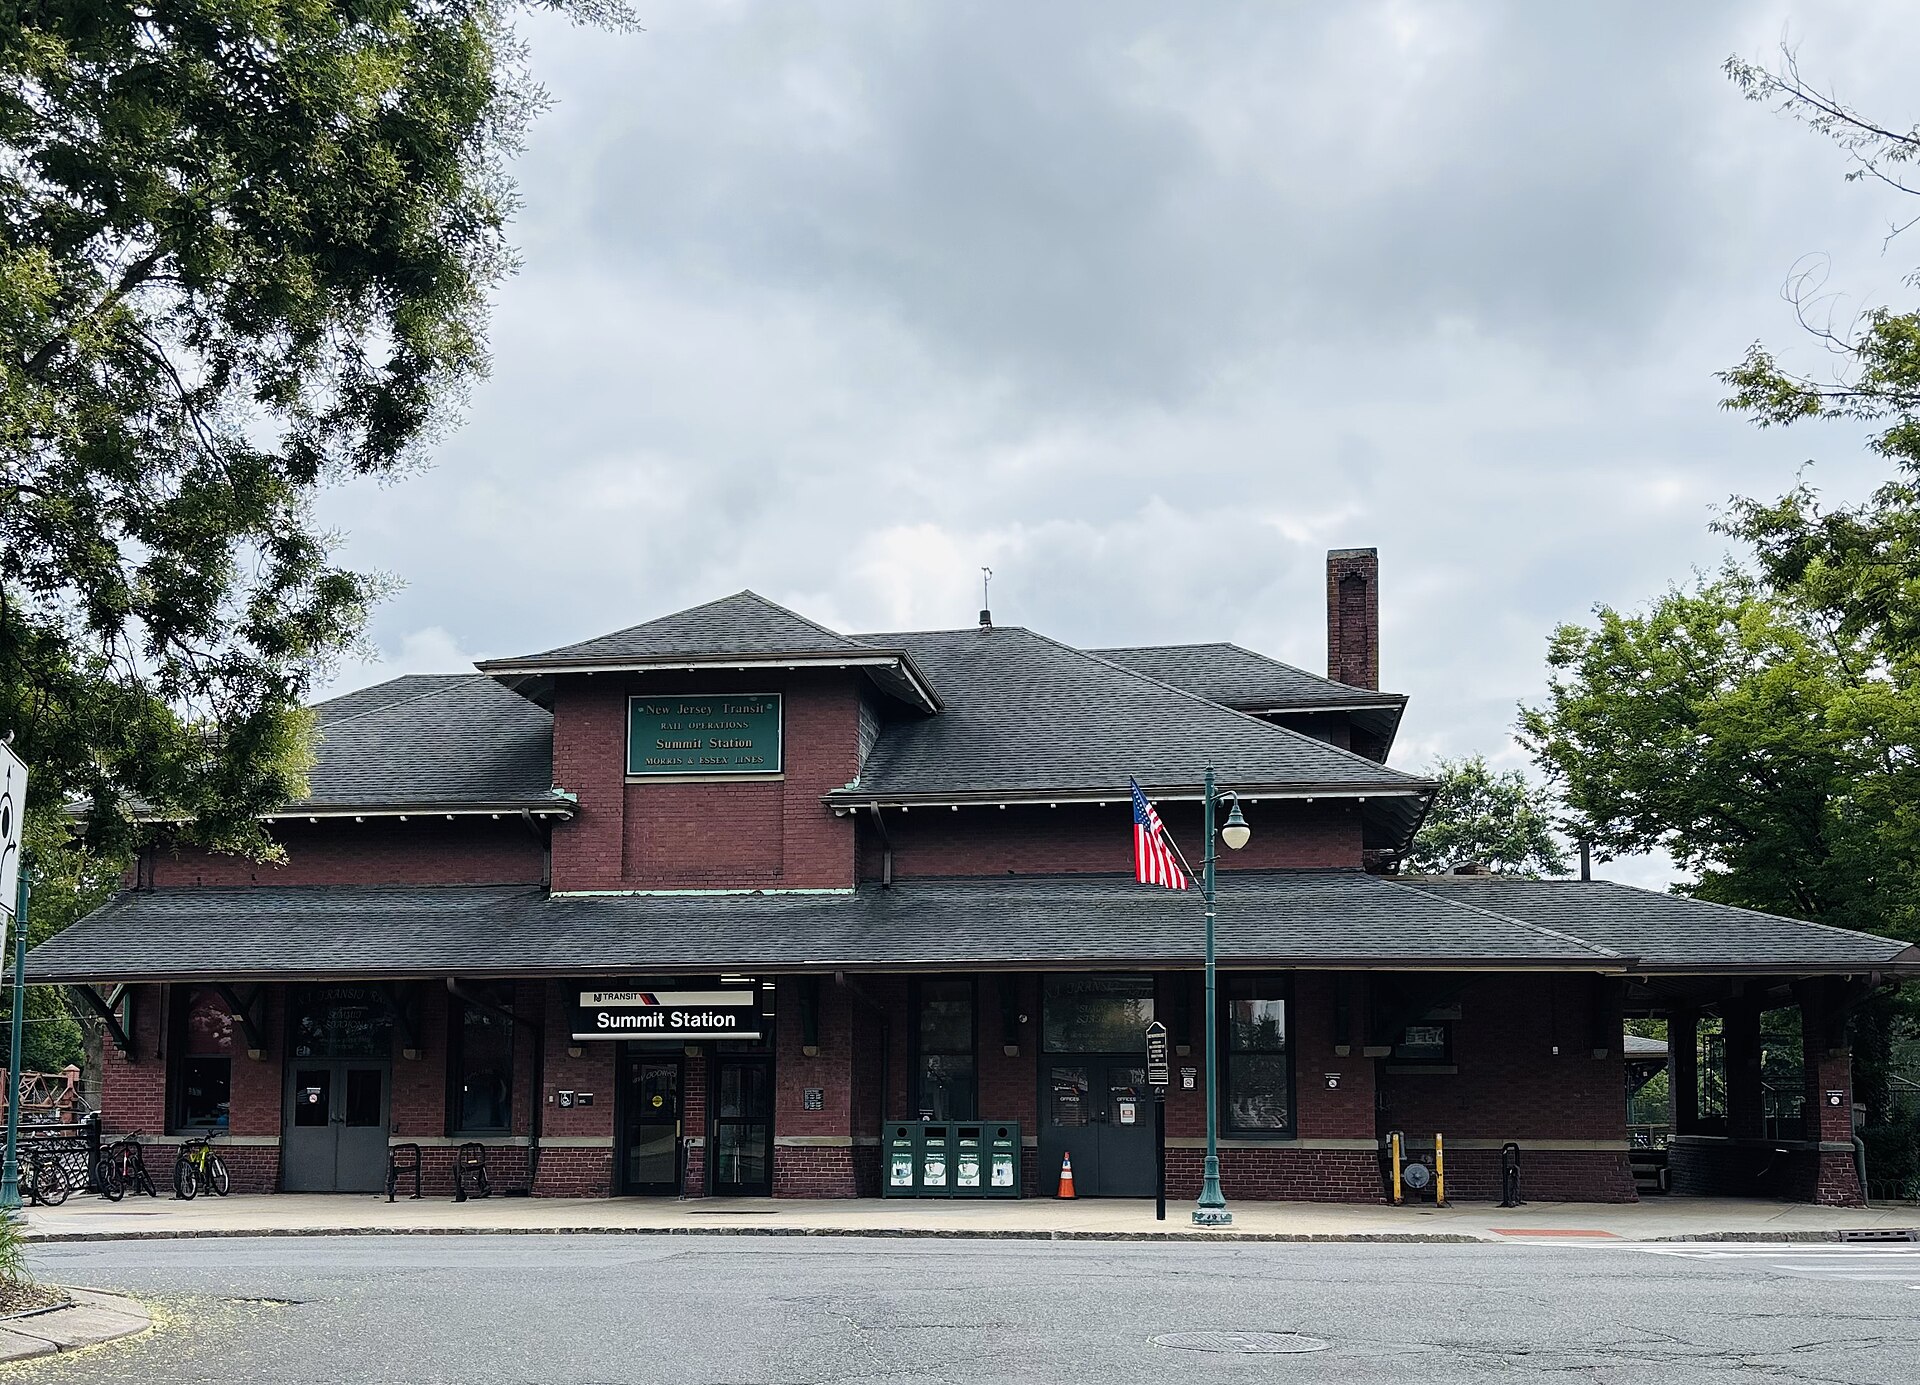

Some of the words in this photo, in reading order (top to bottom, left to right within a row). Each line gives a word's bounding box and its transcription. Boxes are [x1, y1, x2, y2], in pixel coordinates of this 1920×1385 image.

[646, 704, 670, 715] New
[677, 703, 714, 716] Jersey
[722, 703, 765, 714] Transit
[660, 722, 682, 730] RAIL
[688, 721, 749, 730] OPERATIONS
[656, 738, 702, 750] Summit
[709, 737, 753, 749] Station
[645, 757, 682, 766] MORRIS
[687, 757, 694, 765] &
[699, 756, 729, 765] ESSEX
[734, 755, 764, 764] LINES
[603, 992, 638, 1001] TRANSIT
[597, 1011, 665, 1028] Summit
[670, 1011, 736, 1028] Station
